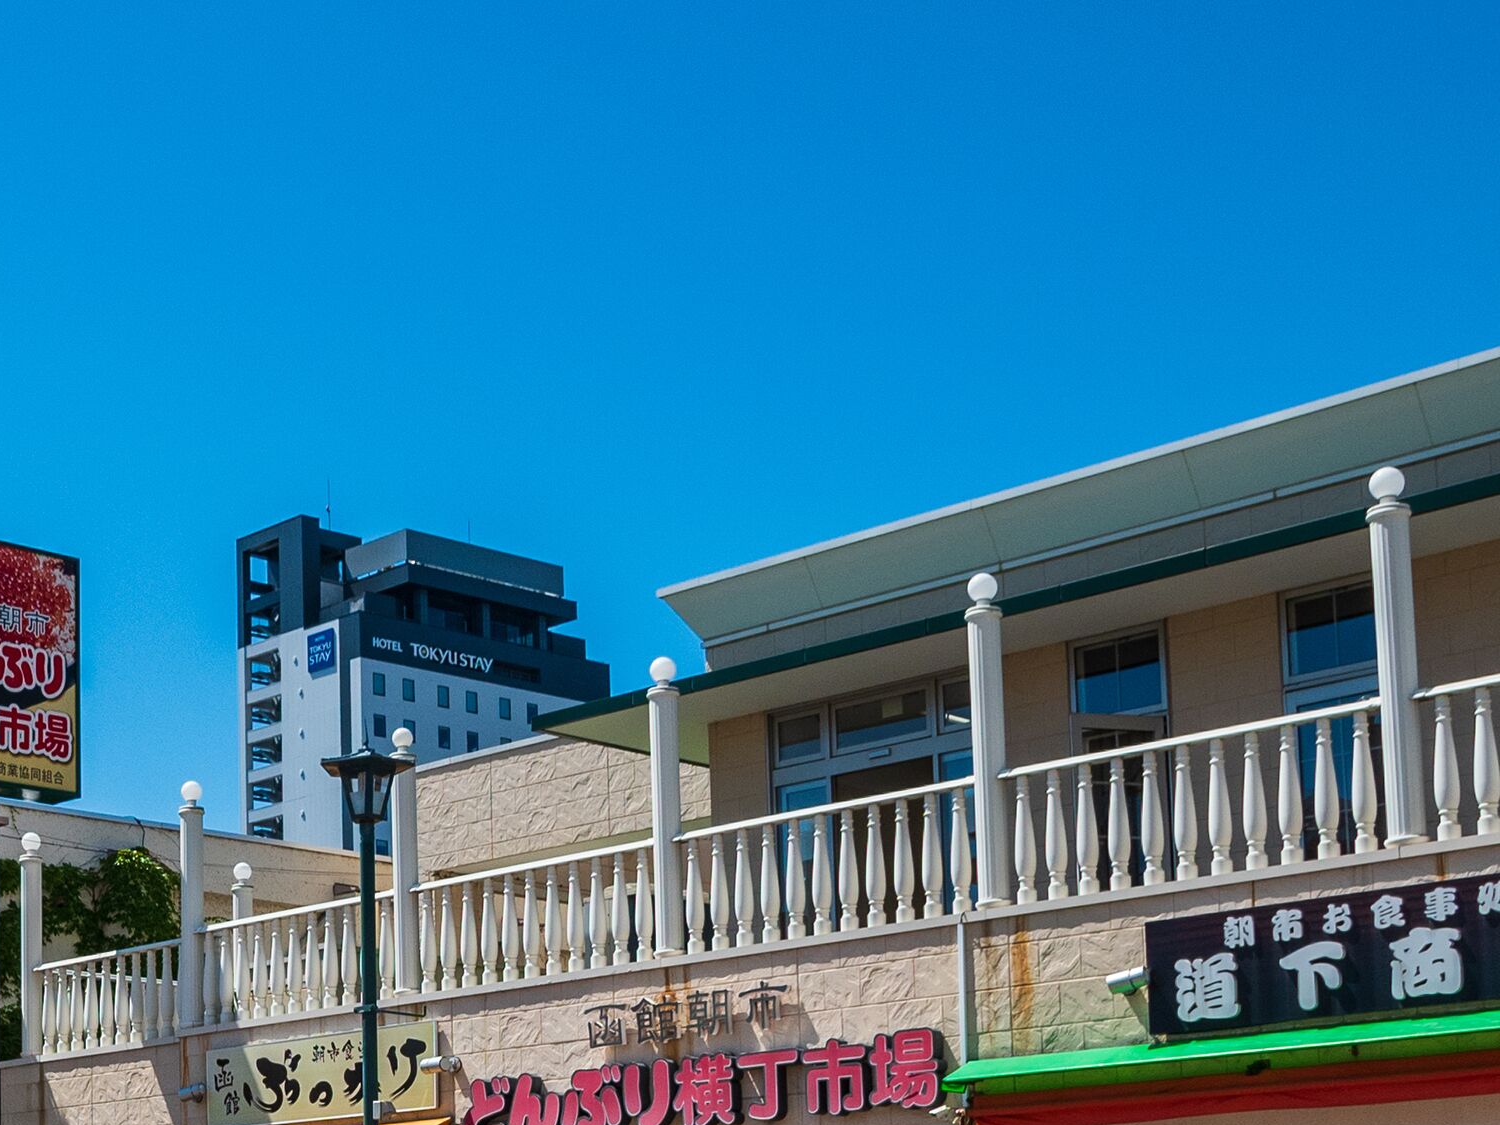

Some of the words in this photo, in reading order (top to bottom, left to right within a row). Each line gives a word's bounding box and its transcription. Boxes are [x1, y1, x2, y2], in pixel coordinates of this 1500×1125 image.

[309, 641, 332, 655] TOKYU
[309, 649, 332, 666] STAY
[372, 636, 403, 653] HOTEL
[410, 642, 458, 665] TOKYU
[458, 654, 494, 673] STAY
[1174, 927, 1464, 1024] 道下商
[586, 980, 790, 1049] 函館朝市
[312, 1039, 363, 1064] 朝市食
[214, 1059, 241, 1116] 函館
